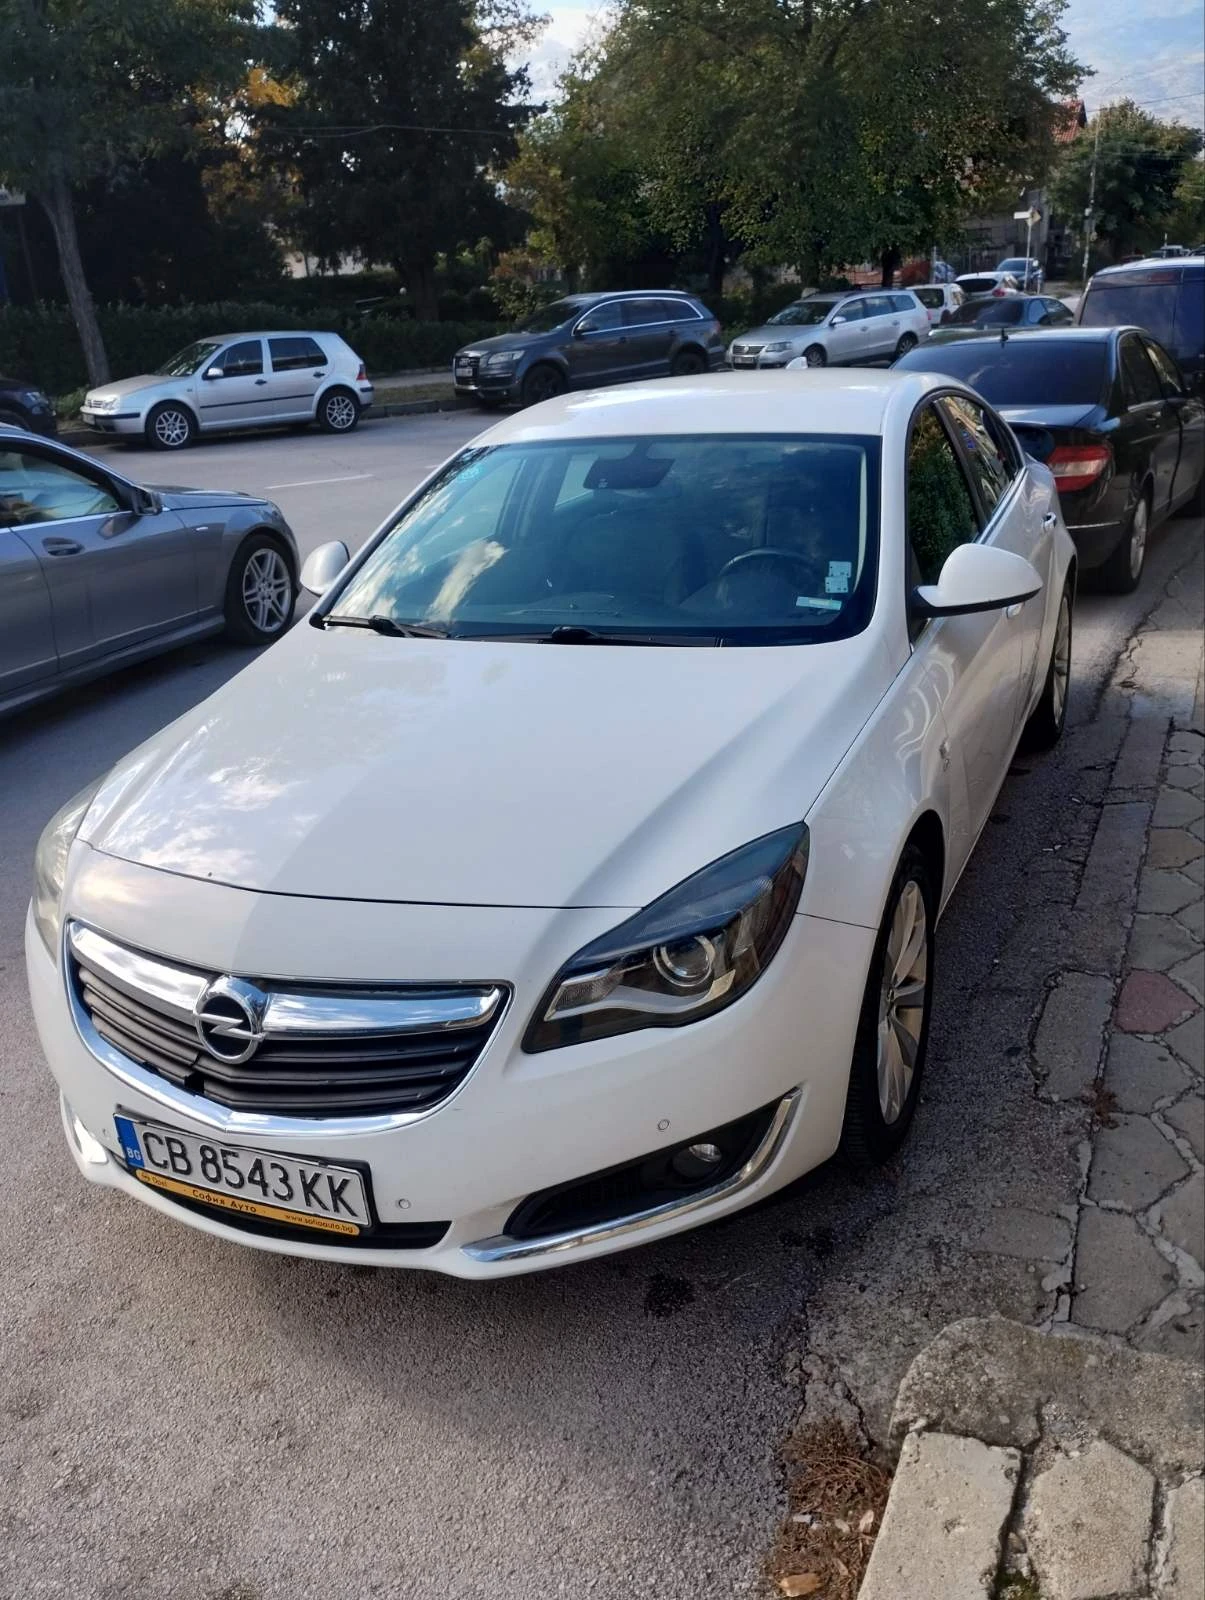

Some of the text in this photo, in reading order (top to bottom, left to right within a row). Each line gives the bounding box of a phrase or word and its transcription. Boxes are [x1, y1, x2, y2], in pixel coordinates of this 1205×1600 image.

[126, 1147, 143, 1162] BG
[142, 1131, 359, 1218] CB 8543 KK
[192, 1189, 257, 1213] София Ауто
